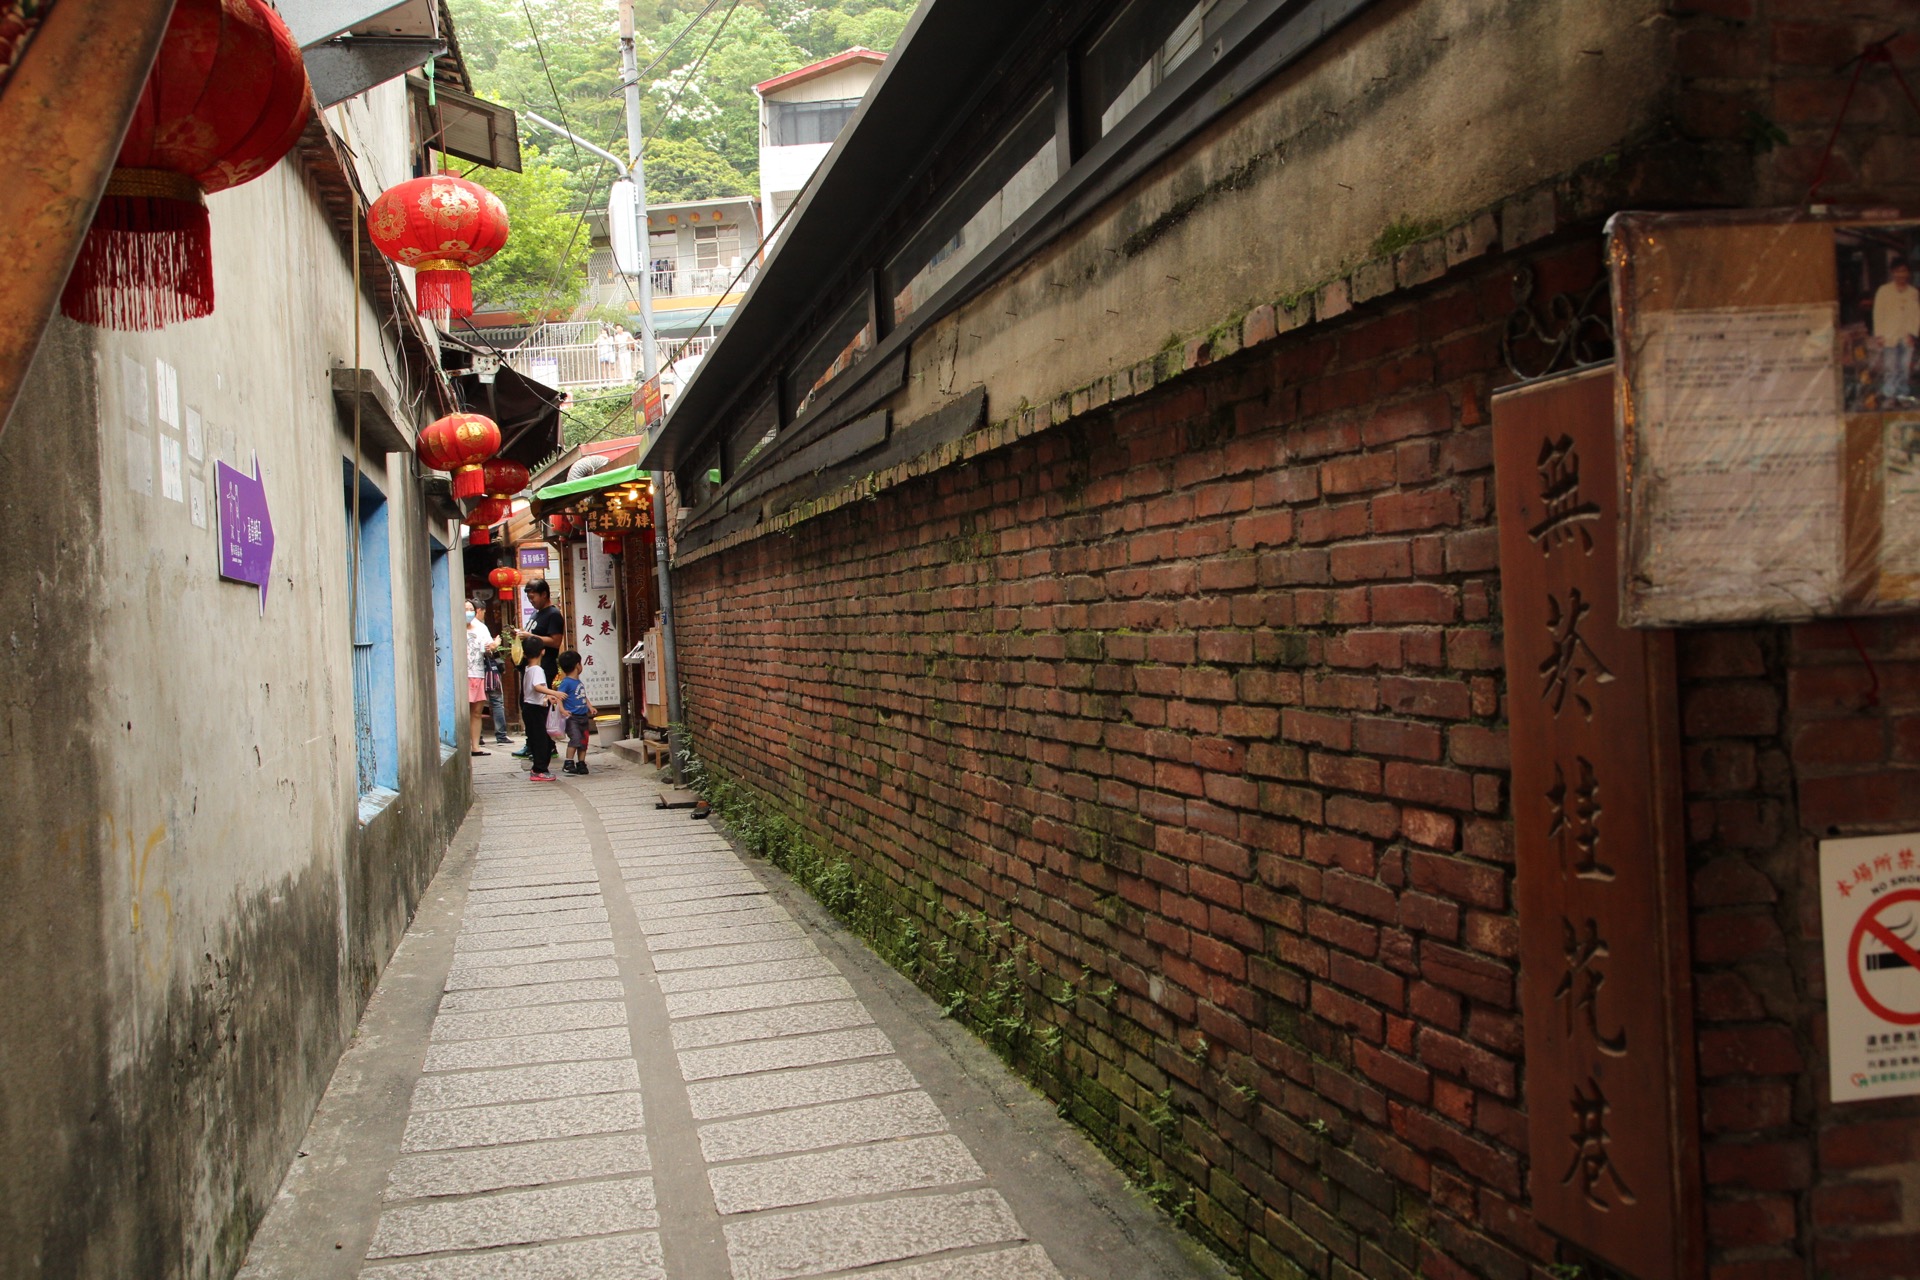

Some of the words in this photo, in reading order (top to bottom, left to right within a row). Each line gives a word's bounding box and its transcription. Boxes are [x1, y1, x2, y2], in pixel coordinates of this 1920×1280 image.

[1837, 848, 1920, 899] 本場所禁
[1871, 882, 1888, 897] NO
